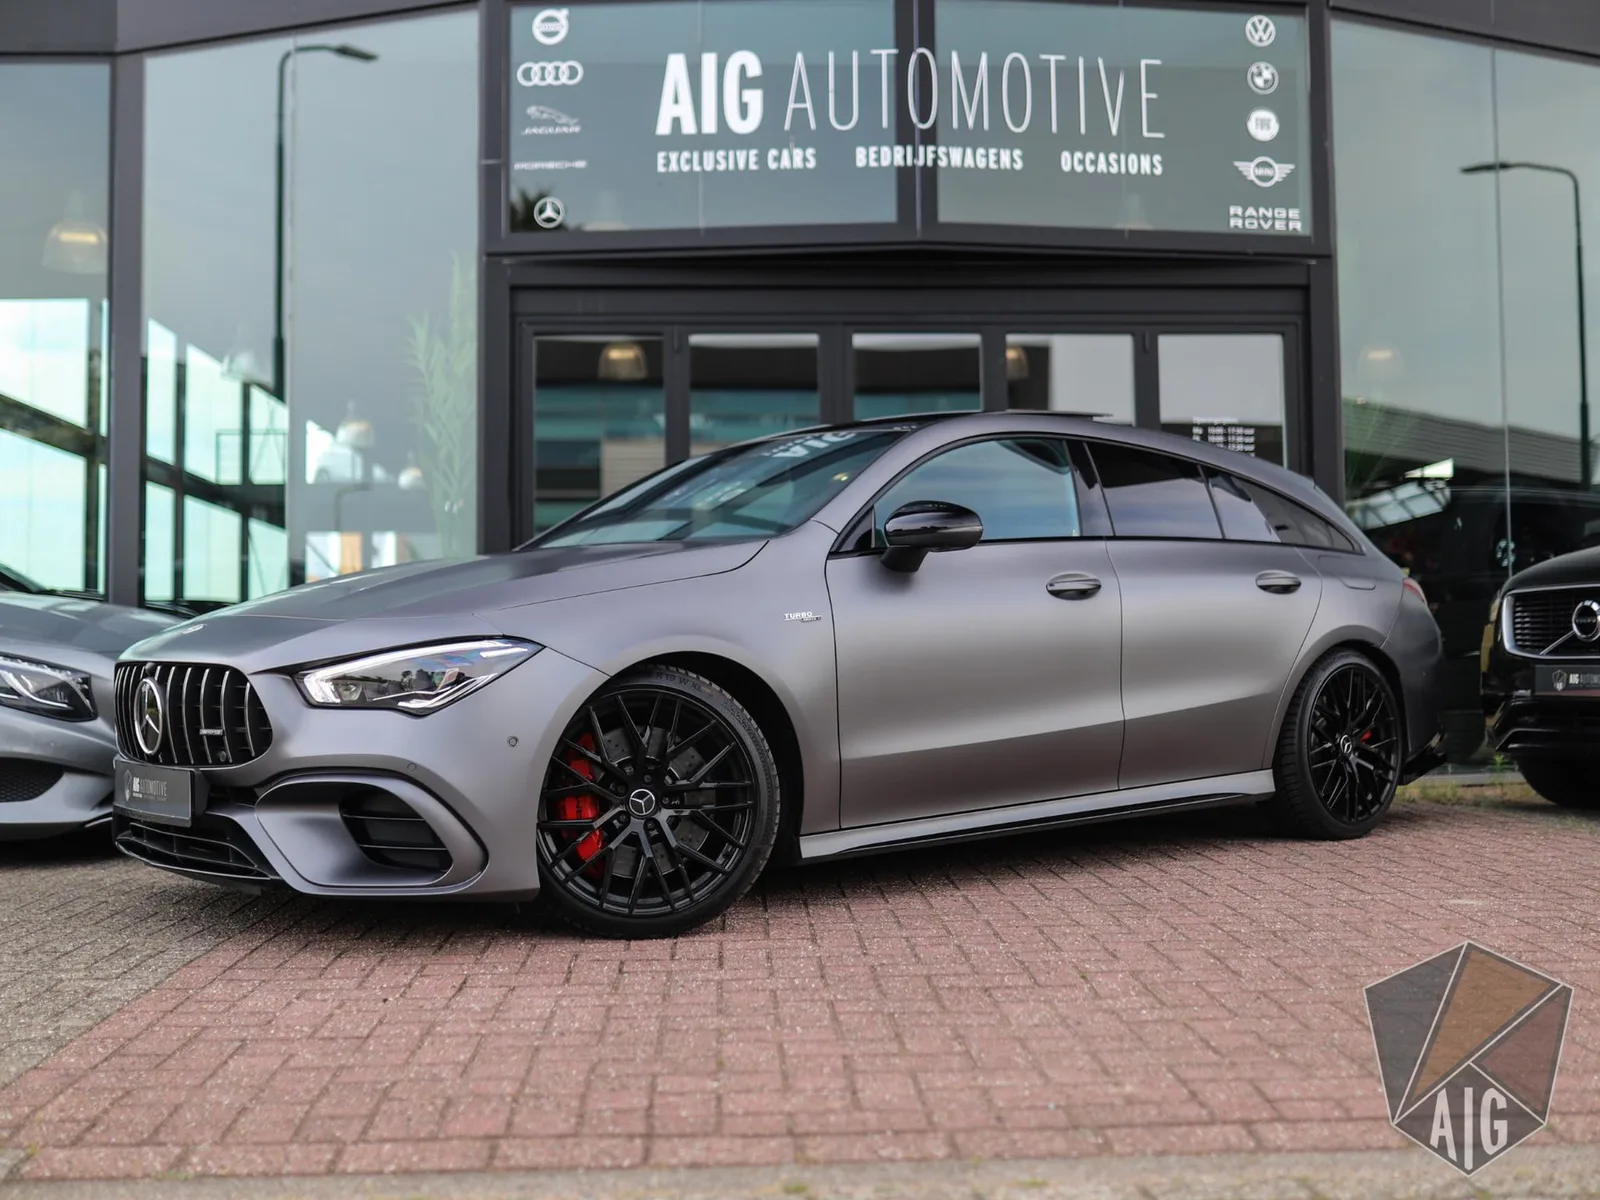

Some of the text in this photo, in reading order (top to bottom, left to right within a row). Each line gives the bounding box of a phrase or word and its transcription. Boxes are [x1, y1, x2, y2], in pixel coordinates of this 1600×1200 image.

[655, 47, 1165, 138] AIG AUTOMOTIVE
[656, 147, 817, 173] EXCLUSIVE CARS
[855, 145, 1024, 171] BEDRIJFSWAGENS
[1060, 150, 1164, 176] OCCASIONS
[1229, 205, 1300, 219] RANGE
[1229, 217, 1302, 231] ROVER
